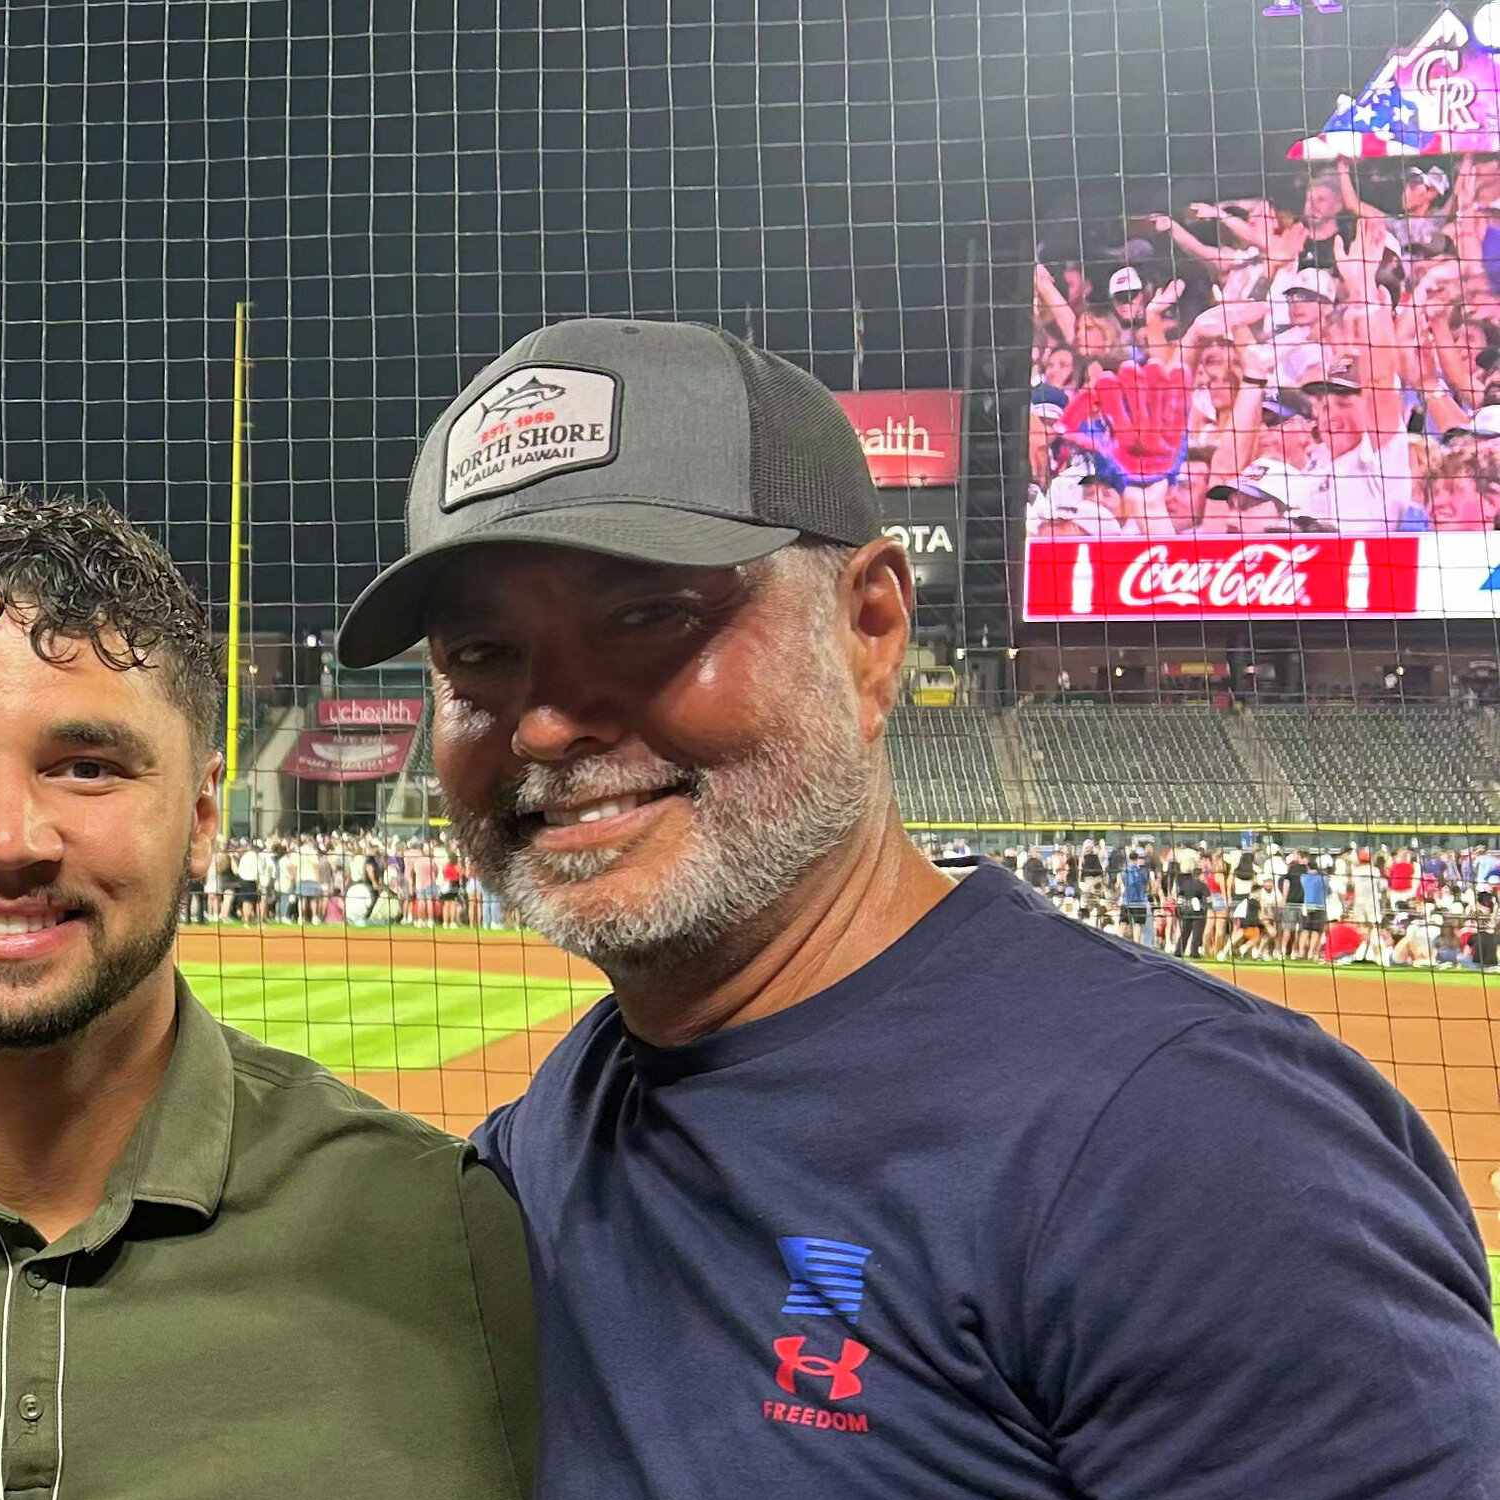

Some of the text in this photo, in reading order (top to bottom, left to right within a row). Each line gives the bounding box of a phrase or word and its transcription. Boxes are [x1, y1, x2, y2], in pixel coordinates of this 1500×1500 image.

[855, 416, 930, 452] alth
[449, 422, 605, 488] NORTH SHORE
[464, 447, 575, 491] KAUAI HAWAII
[881, 525, 954, 553] OTA
[329, 700, 411, 724] uchealth
[762, 1400, 870, 1433] FREEDOM
